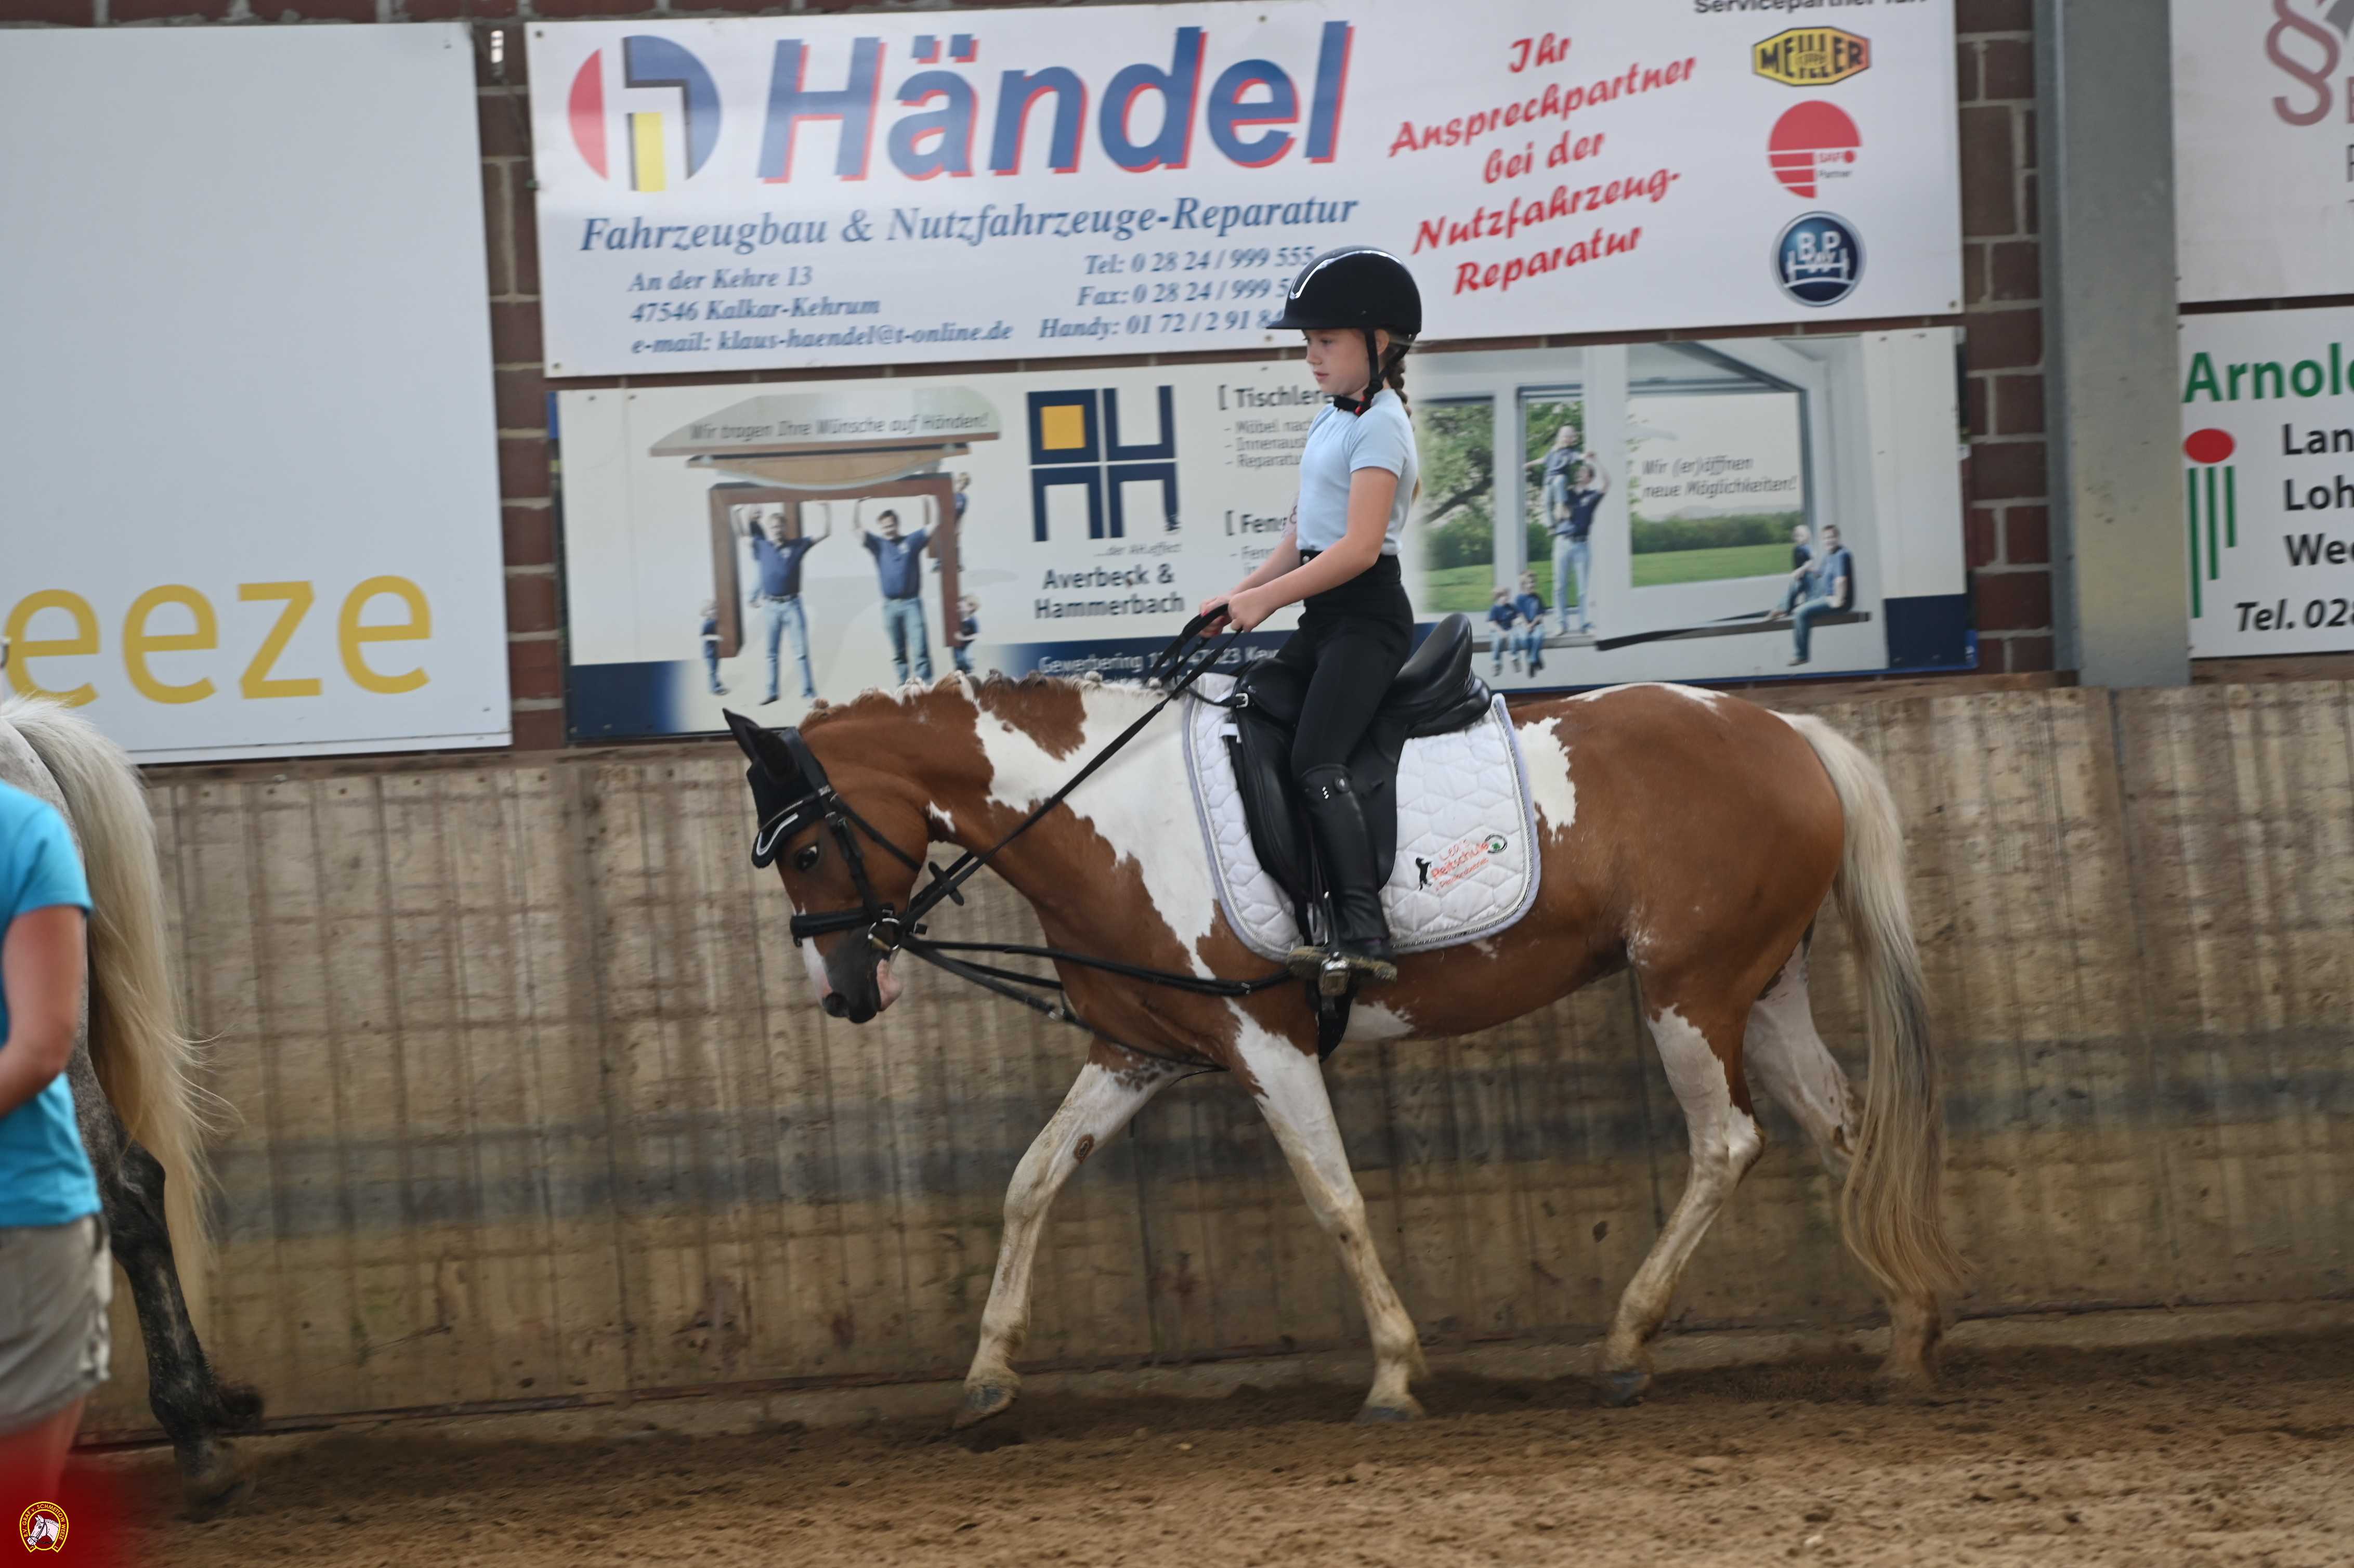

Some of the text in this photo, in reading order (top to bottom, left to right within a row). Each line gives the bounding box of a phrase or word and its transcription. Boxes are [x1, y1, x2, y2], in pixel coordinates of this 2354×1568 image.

[1509, 32, 1571, 72] Ihr
[757, 20, 1355, 184] Händel
[1388, 57, 1696, 157] Ansprechpartner
[1484, 130, 1604, 184] bei der
[580, 196, 1359, 255] Fahrzeugbau & Nutzfahrzeuge-Reparatur
[1411, 168, 1681, 254] Nutzfahrzeug-
[1084, 253, 1125, 275] Tel:
[1150, 252, 1180, 272] 28
[1183, 250, 1210, 270] 24
[1229, 247, 1270, 268] 999
[1274, 246, 1316, 267] 555
[1453, 227, 1642, 295] Reparatur
[627, 266, 813, 292] An der Kehre 13
[1076, 285, 1127, 306] Fax:
[1152, 282, 1180, 303] 28
[1185, 281, 1212, 301] 24
[1232, 278, 1272, 299] 999
[630, 296, 881, 322] 47546 Kalkar-Kehrum
[1038, 315, 1120, 340] Handy:
[1126, 314, 1153, 334] 01
[1161, 313, 1184, 333] 72
[1205, 311, 1220, 331] 2
[1224, 309, 1249, 331] 91
[631, 319, 1014, 354] e-mail: klaus-haendel@t-online.de
[2182, 342, 2354, 403] Arnol
[690, 423, 717, 439] Wir
[1642, 458, 1668, 475] Wir
[2283, 532, 2354, 566] We
[1042, 563, 1174, 590] Averbeck &
[1035, 592, 1185, 619] Hammerbach
[2234, 597, 2354, 632] Tel. 02
[1039, 651, 1143, 674] Gewerbering
